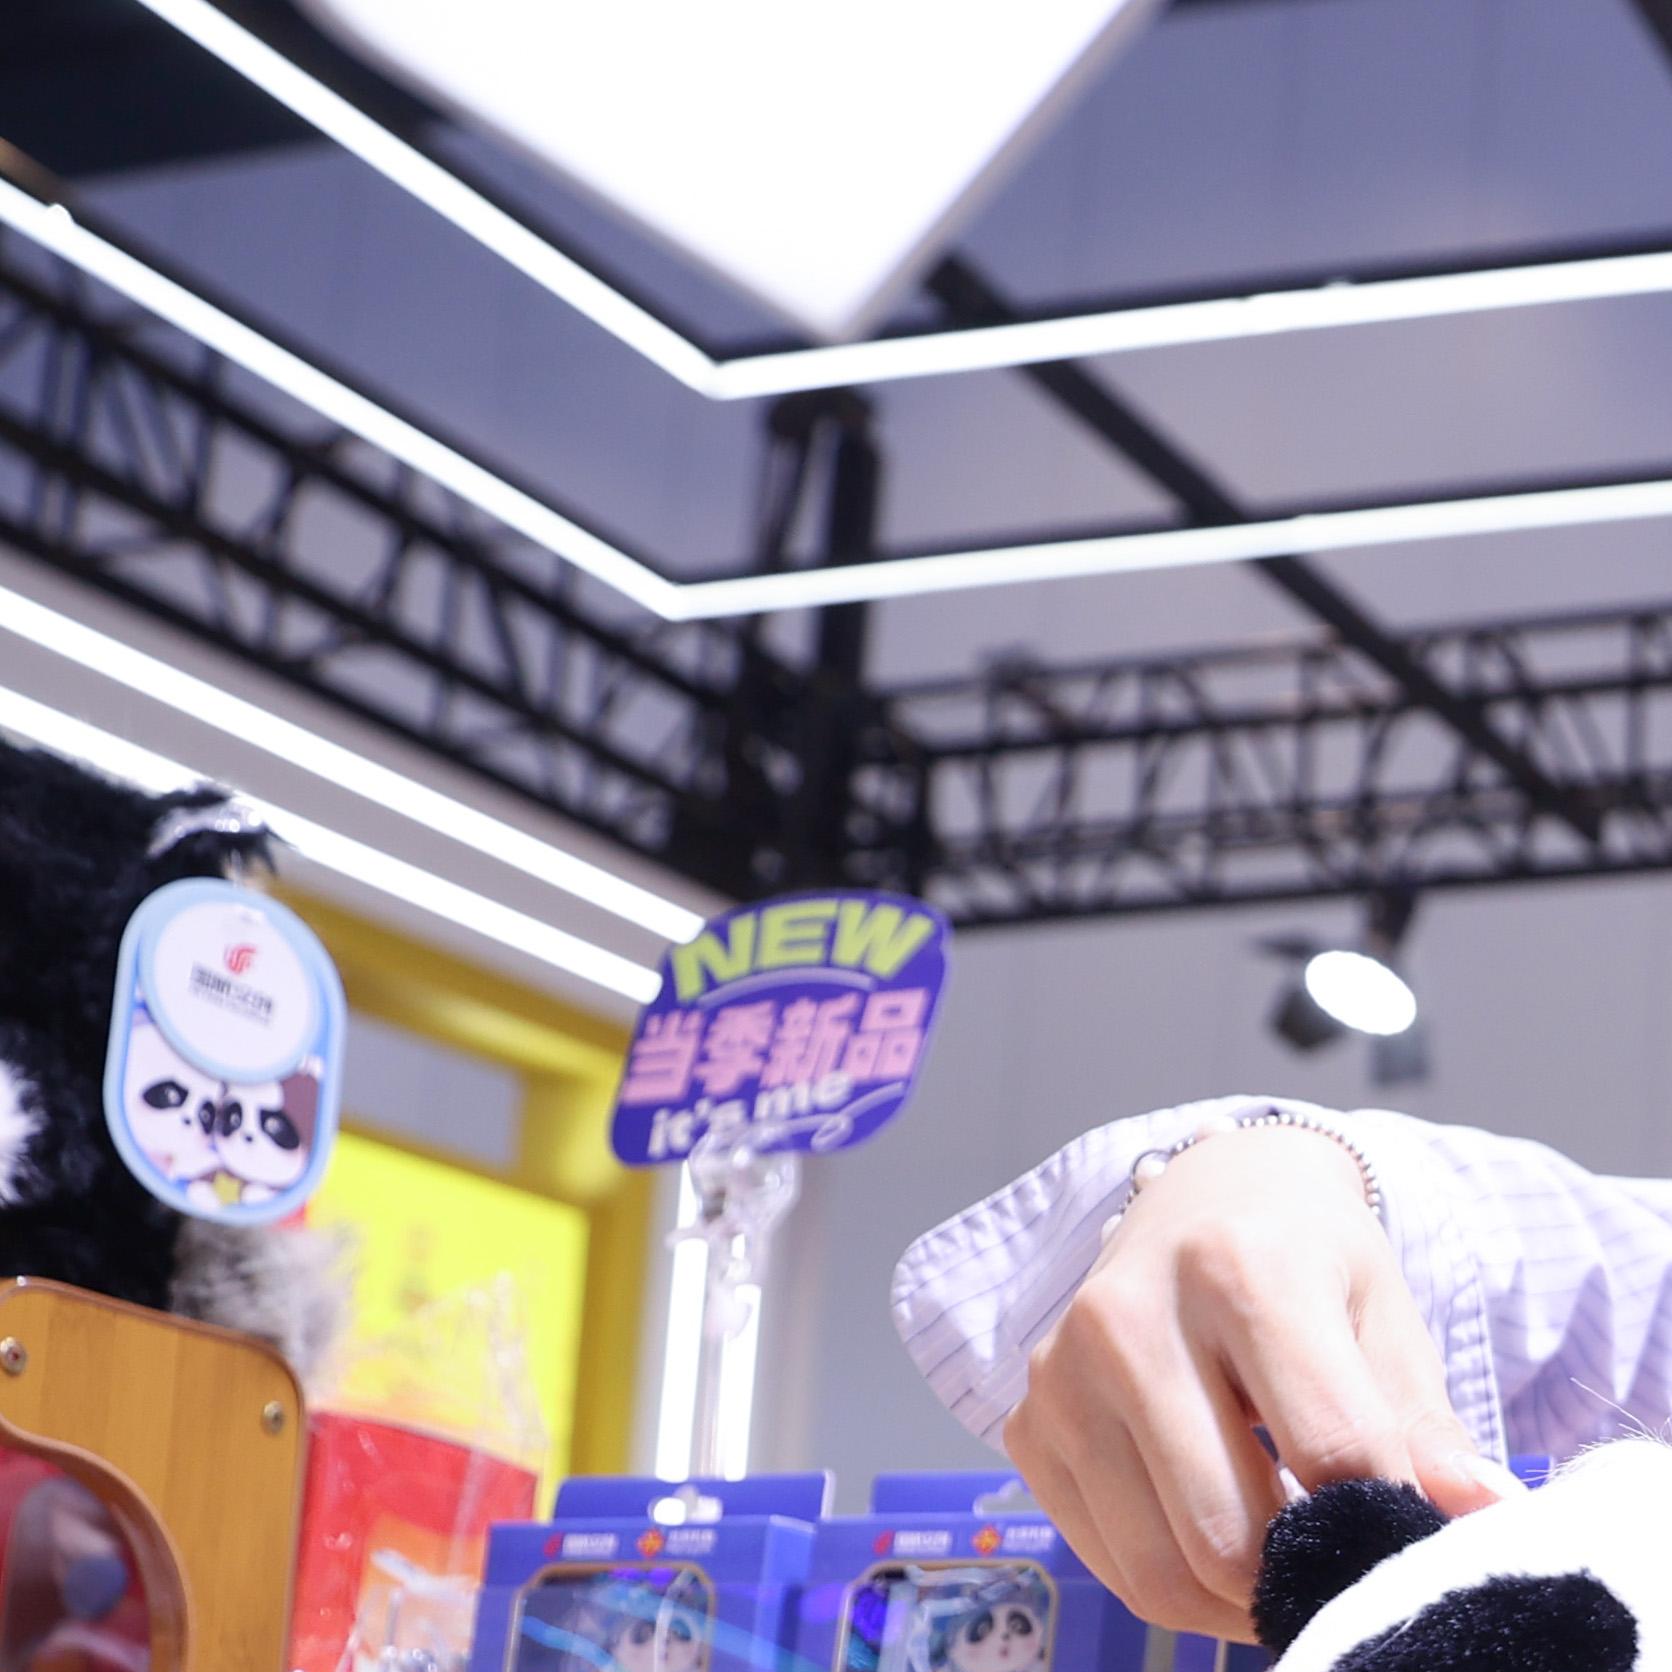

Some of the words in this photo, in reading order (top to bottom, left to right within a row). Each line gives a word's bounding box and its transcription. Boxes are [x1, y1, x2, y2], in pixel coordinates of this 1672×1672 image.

[670, 898, 935, 1003] NEW
[622, 985, 930, 1103] 当季新品
[752, 1068, 852, 1120] me
